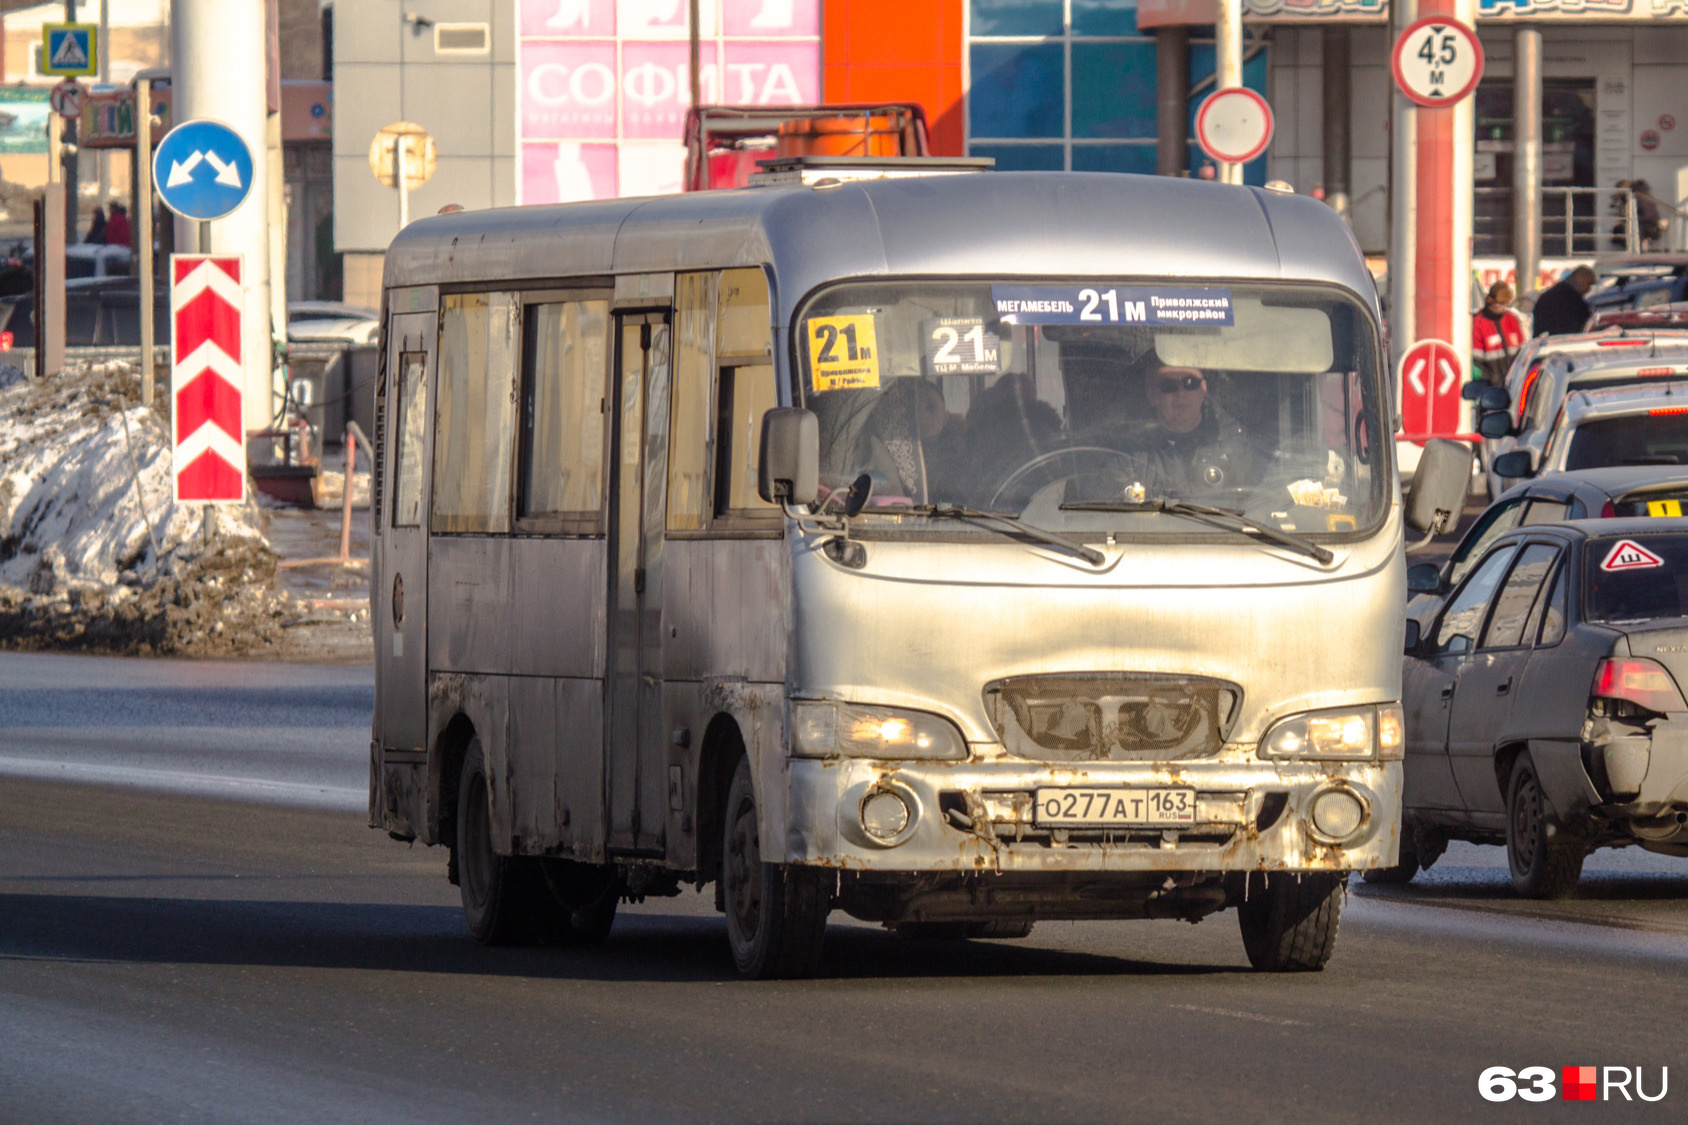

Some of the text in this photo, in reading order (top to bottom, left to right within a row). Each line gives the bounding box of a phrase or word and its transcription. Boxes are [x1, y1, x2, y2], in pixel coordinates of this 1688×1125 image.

[1418, 34, 1457, 69] 4,5
[997, 299, 1074, 313] МЕГАМЕБЕЛЬ
[1078, 288, 1119, 322] 21
[1150, 295, 1230, 309] Приволжский
[1156, 308, 1226, 321] микрорайон
[1150, 792, 1187, 812] 163
[1158, 811, 1178, 820] RUS
